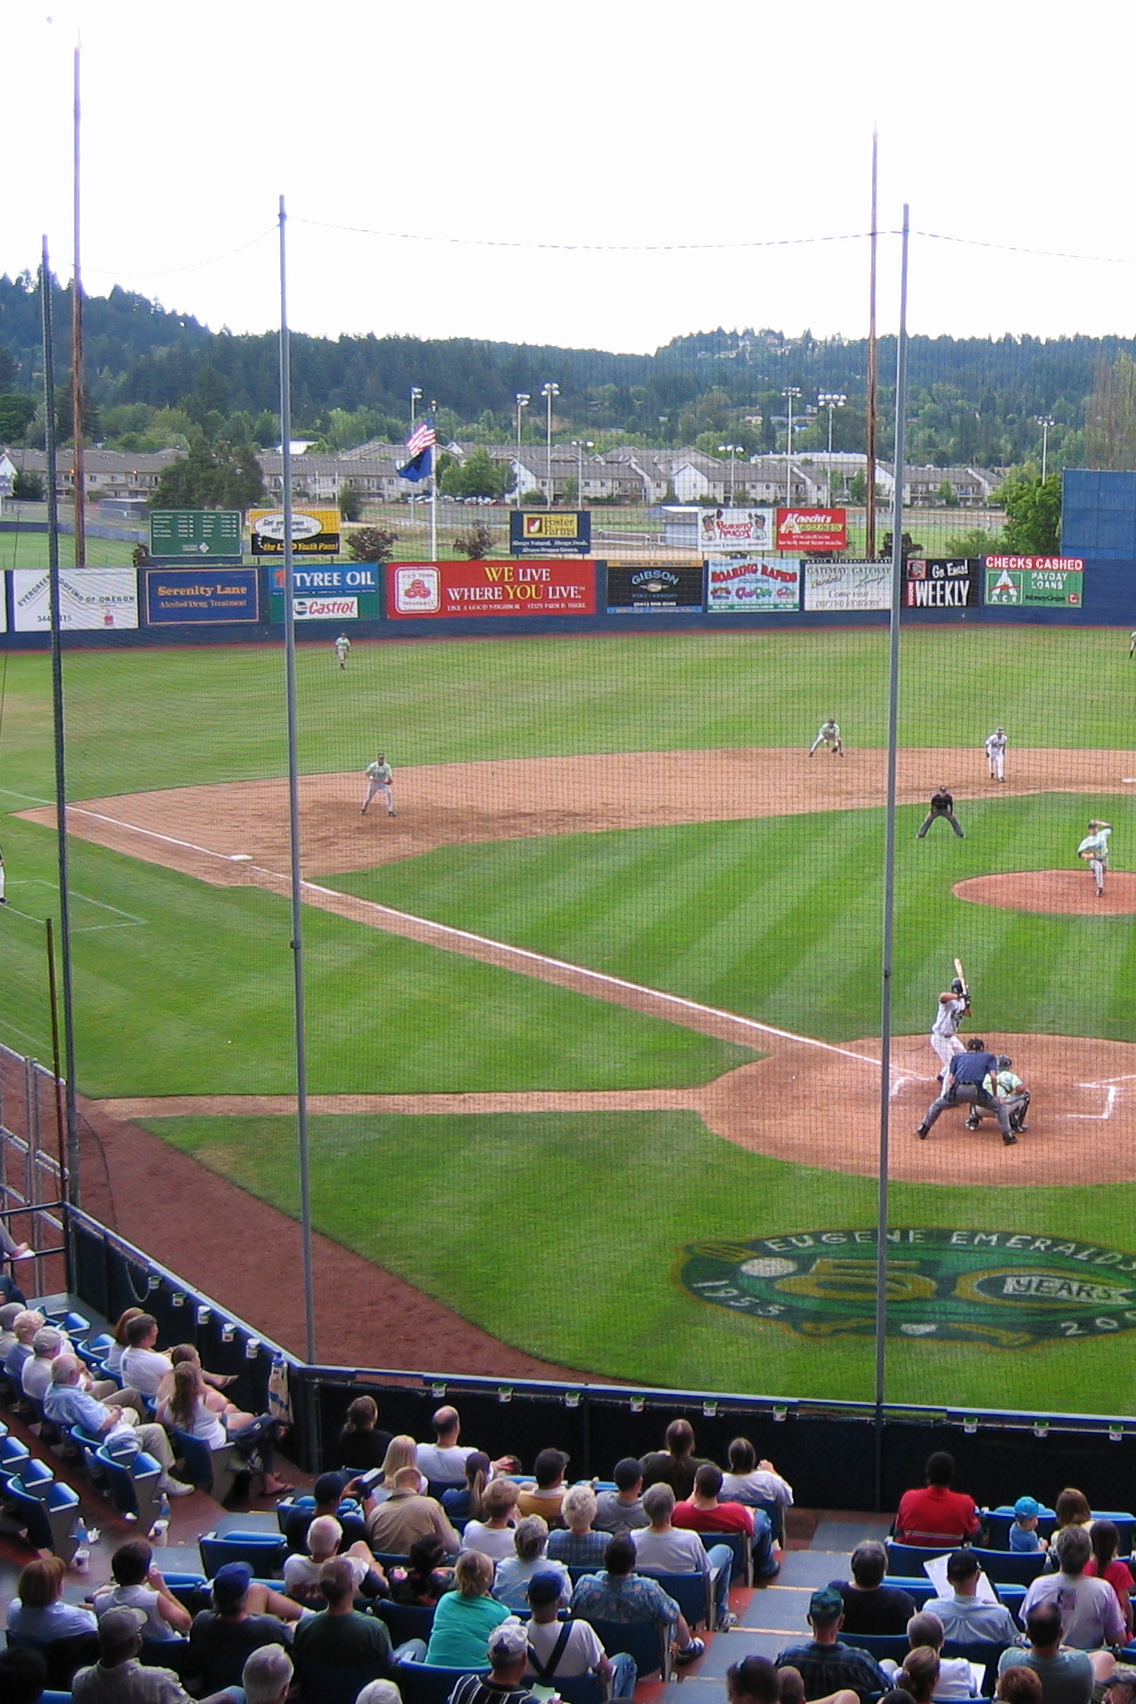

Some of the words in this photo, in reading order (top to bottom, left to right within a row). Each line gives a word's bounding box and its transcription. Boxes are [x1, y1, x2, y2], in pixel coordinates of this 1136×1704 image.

[985, 556, 1033, 569] CHECKS
[1036, 558, 1083, 571] CASHED
[293, 572, 342, 587] TYREE
[346, 571, 375, 586] OIL
[484, 566, 514, 582] WE
[519, 568, 551, 582] LIVE
[631, 570, 680, 585] GIBSON
[1031, 571, 1068, 581] PAYDAY
[158, 586, 214, 596] Serenity
[216, 585, 248, 595] Lane
[447, 587, 503, 601] WHERE
[504, 584, 544, 600] YOU
[1031, 580, 1063, 590] LOANS
[915, 580, 970, 607] WEEKLY
[309, 601, 354, 615] Castrol
[763, 1229, 927, 1251] EUGENE
[1007, 1276, 1124, 1302] YEARS
[692, 1279, 787, 1316] 1955
